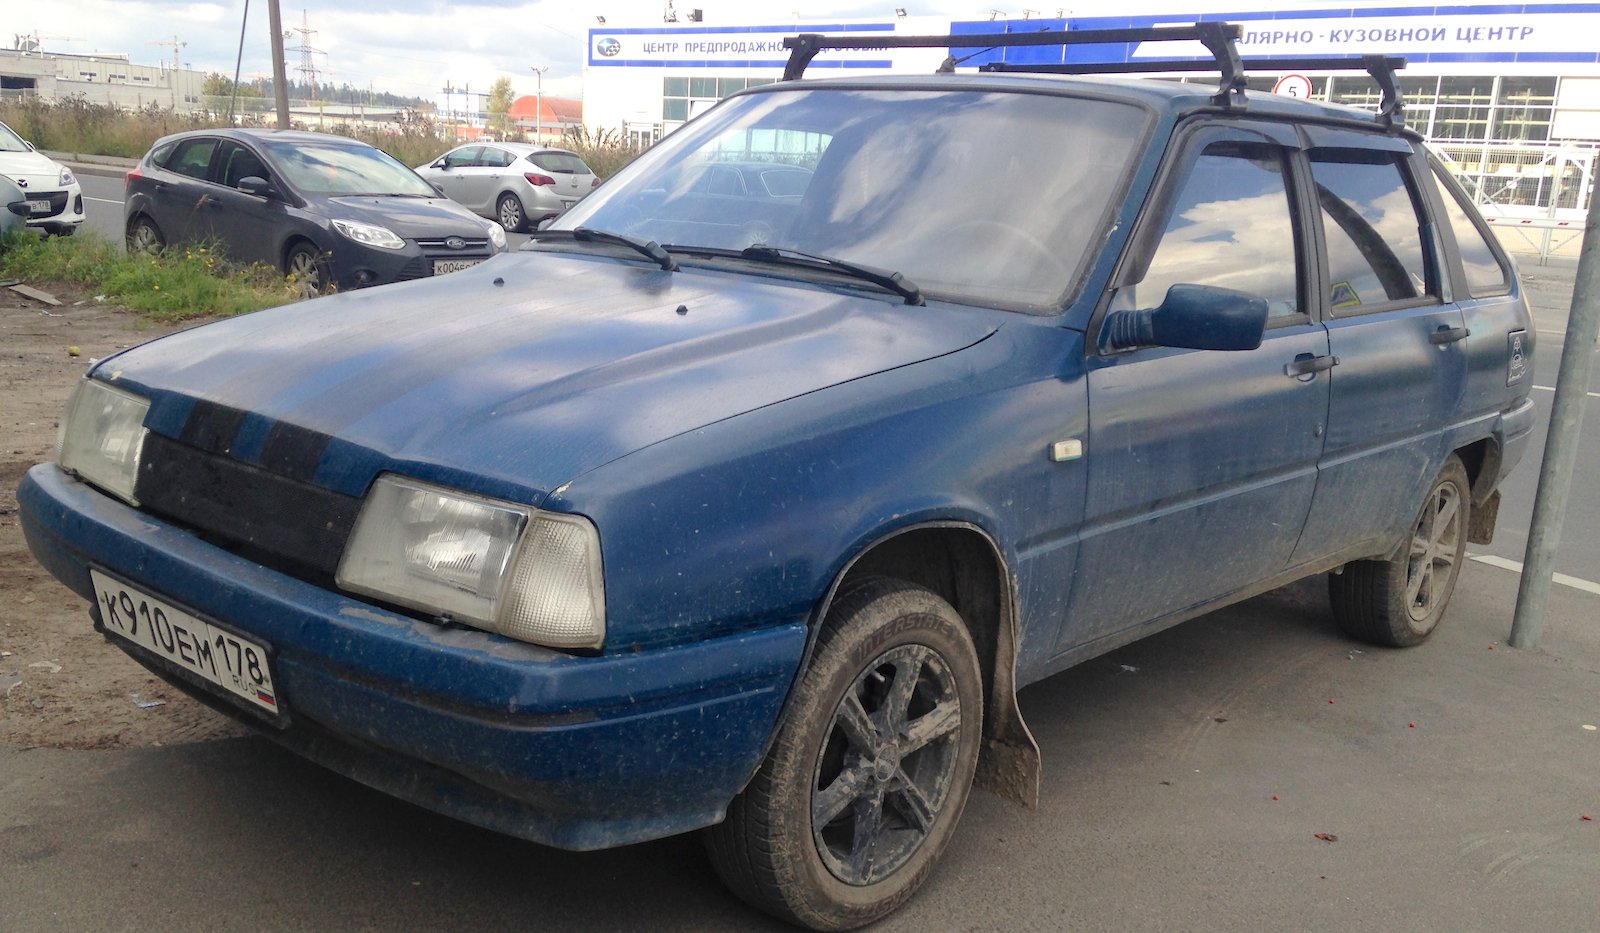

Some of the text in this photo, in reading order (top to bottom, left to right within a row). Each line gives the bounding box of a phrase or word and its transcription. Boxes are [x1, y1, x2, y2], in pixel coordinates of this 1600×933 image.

[1234, 30, 1313, 45] ЛЯРНО
[1329, 24, 1446, 43] КУЗОВНОЙ
[1456, 26, 1534, 43] ЦЕНТР
[643, 42, 679, 54] ЦЕНТР
[1289, 86, 1297, 97] 5
[232, 674, 257, 696] RUS
